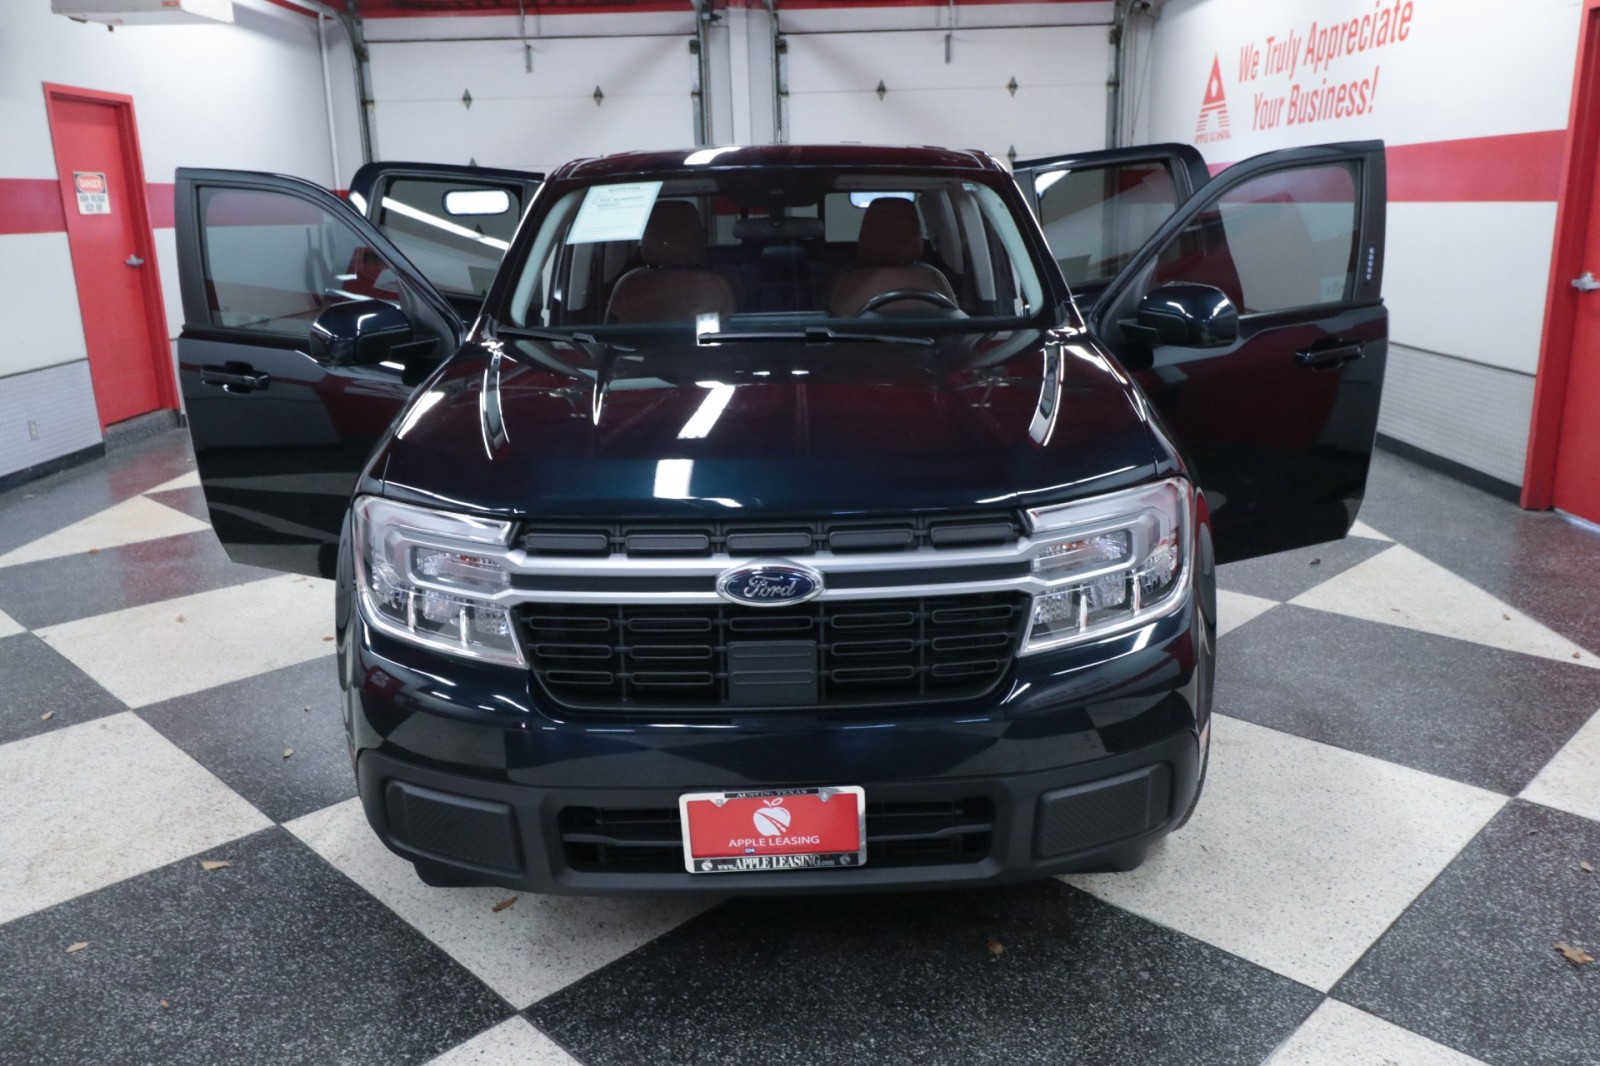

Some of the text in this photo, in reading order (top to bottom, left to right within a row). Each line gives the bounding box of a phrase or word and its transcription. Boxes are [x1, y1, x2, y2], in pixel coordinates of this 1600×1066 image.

[1239, 0, 1413, 83] We Truly Appreciate
[1253, 66, 1380, 131] Your Business!
[79, 178, 102, 189] DANGER
[743, 575, 797, 598] Ford
[728, 835, 820, 848] APPLE LEASING
